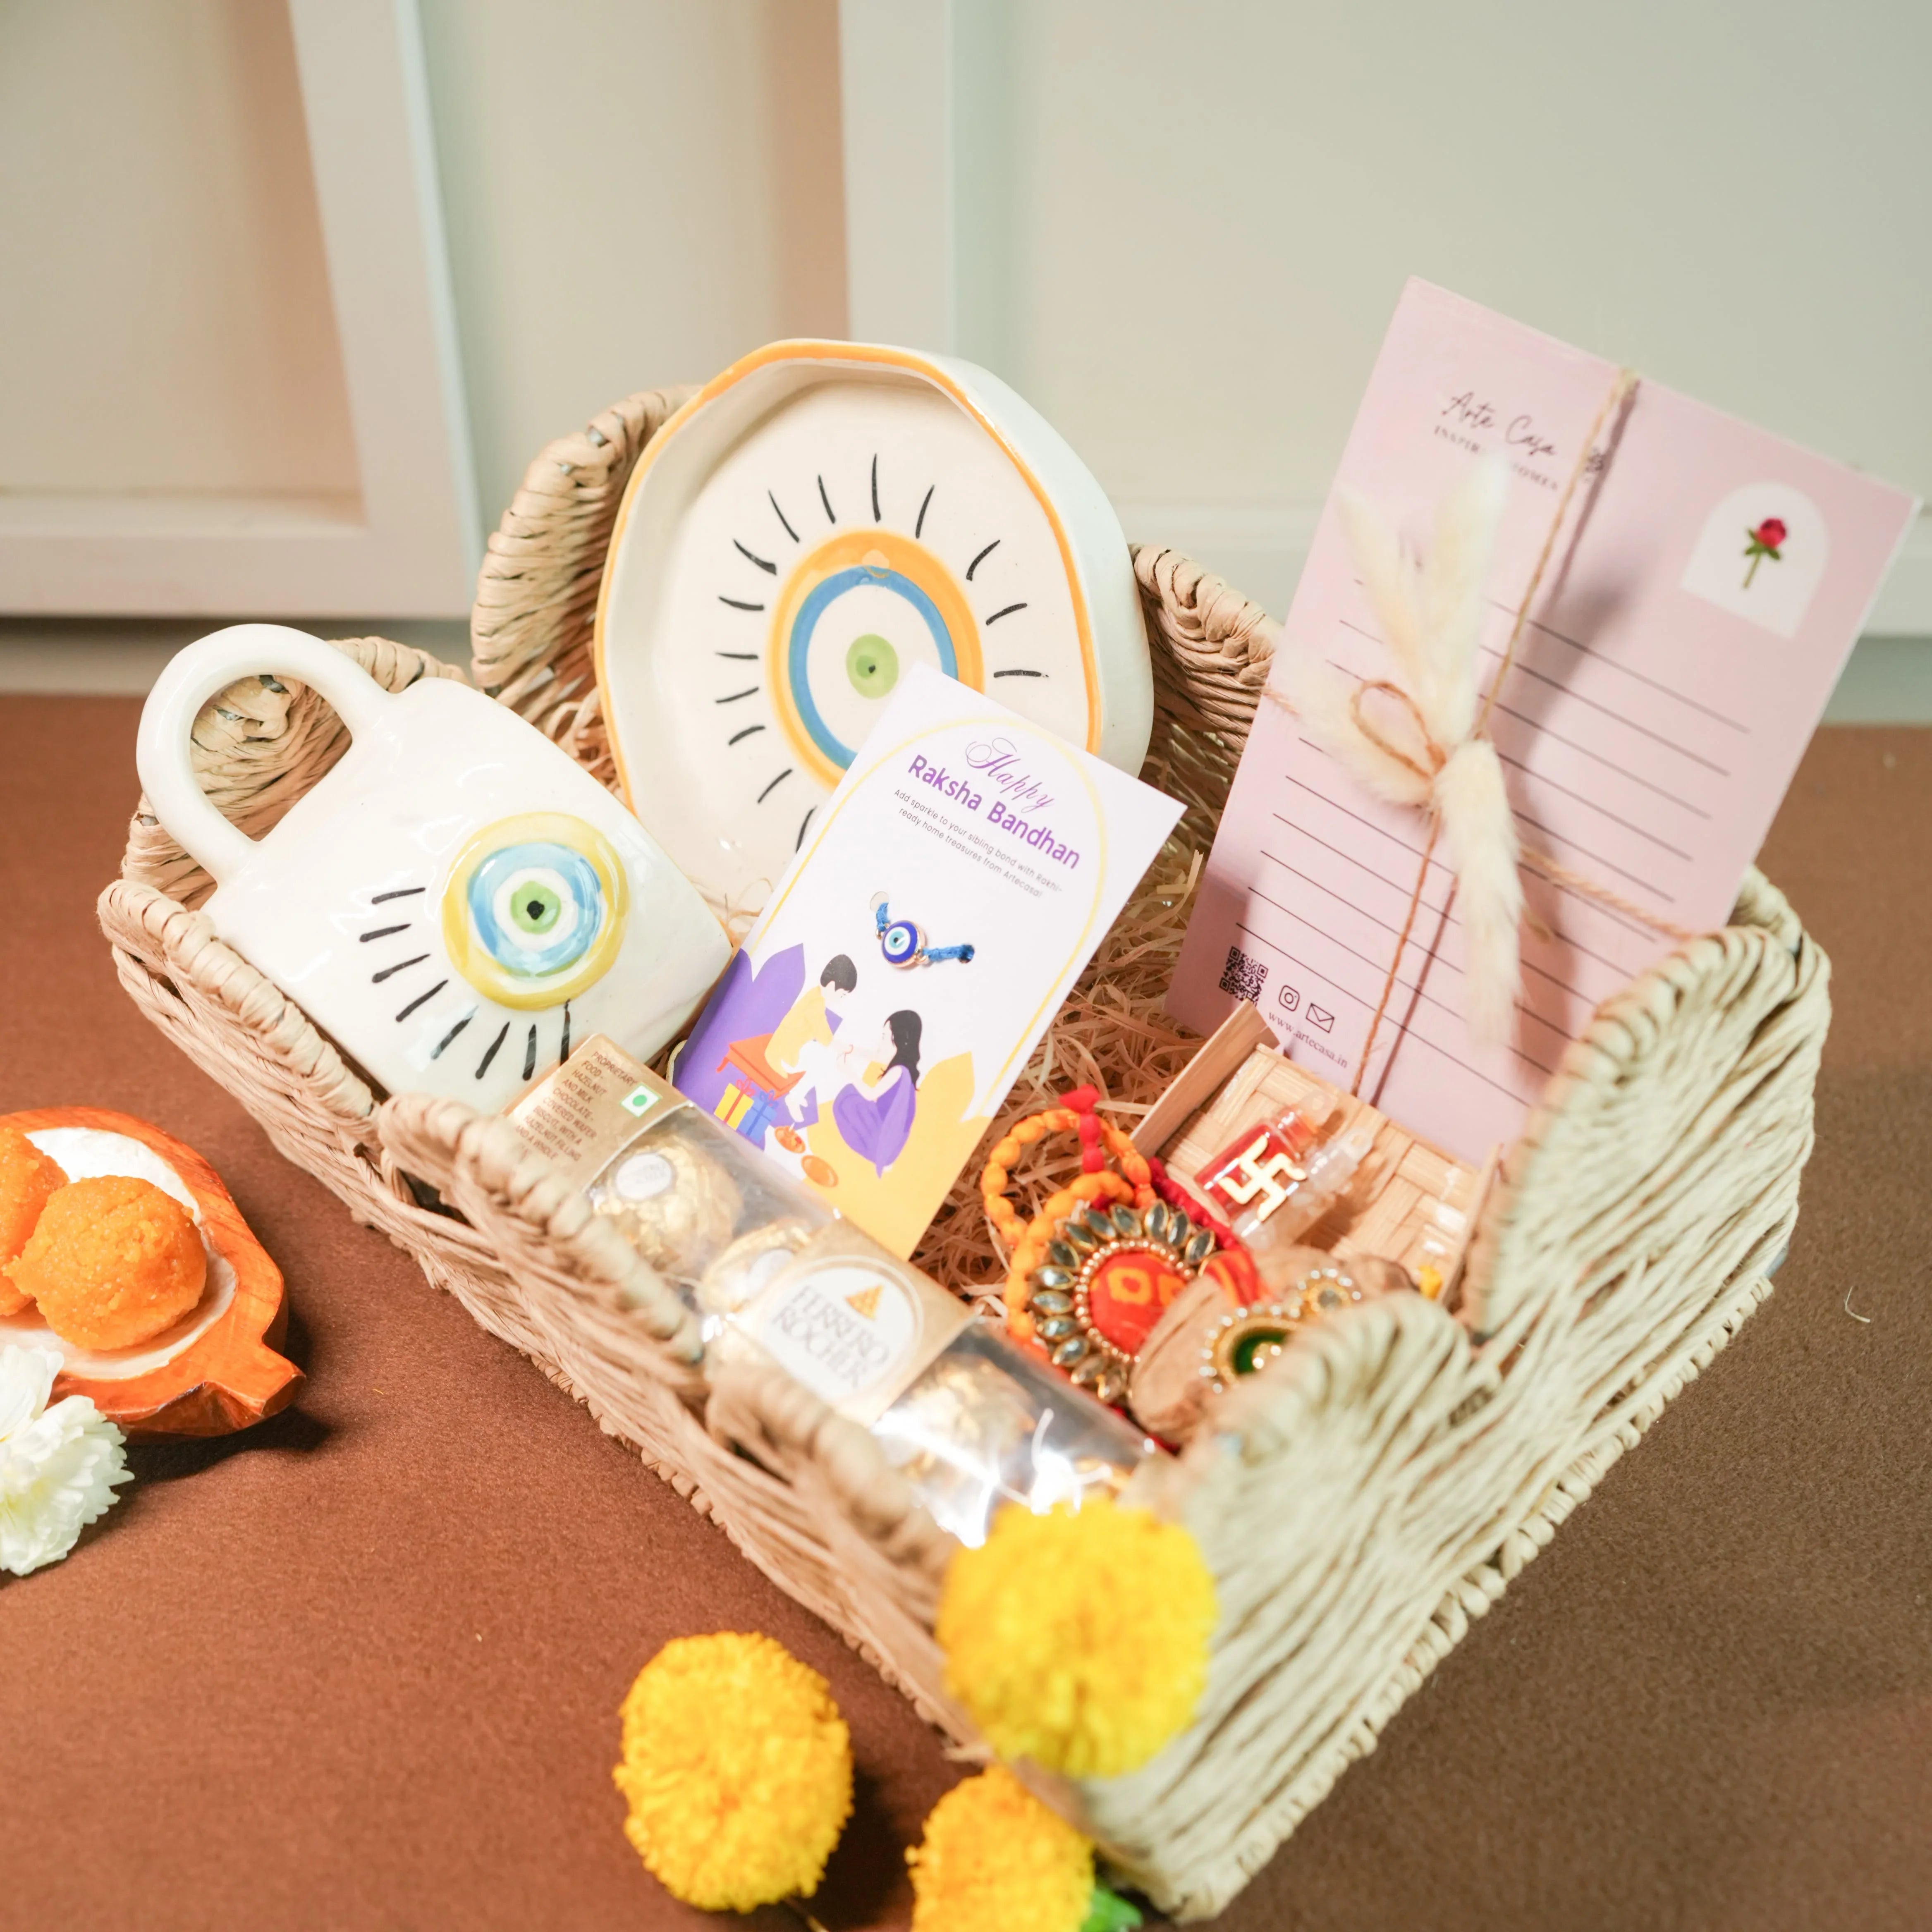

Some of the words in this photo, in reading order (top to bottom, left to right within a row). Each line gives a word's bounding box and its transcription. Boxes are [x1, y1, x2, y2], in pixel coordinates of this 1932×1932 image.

[1441, 391, 1496, 429] Arte
[1506, 415, 1556, 457] Casa
[966, 737, 1054, 813] Happy
[894, 789, 911, 802] Add
[911, 799, 938, 819] sparkle
[940, 816, 948, 825] to
[948, 822, 967, 836] your
[968, 834, 994, 855] sibling
[995, 849, 1017, 866] bond
[1018, 863, 1035, 877] with
[899, 808, 921, 826] ready
[922, 820, 944, 839] home
[945, 835, 982, 862] treasures
[983, 857, 1002, 873] from
[908, 754, 982, 811] Raksha
[987, 801, 1080, 869] Bandhan
[591, 1051, 638, 1087] PROPRIETARY
[1268, 1011, 1348, 1069] www.artecasa.in
[562, 1078, 578, 1091] AND
[576, 1088, 594, 1104] MILK
[571, 1069, 607, 1095] HAZELNUT
[515, 1125, 529, 1138] AND
[533, 1139, 559, 1160] WHOLE
[525, 1115, 558, 1143] HAZELNUT
[555, 1139, 582, 1162] FILLING
[543, 1097, 574, 1122] COVERED
[573, 1119, 597, 1140] WAFER
[559, 1125, 576, 1141] WITH
[772, 1305, 868, 1388] ROCHER
[792, 1285, 890, 1365] FERRERO
